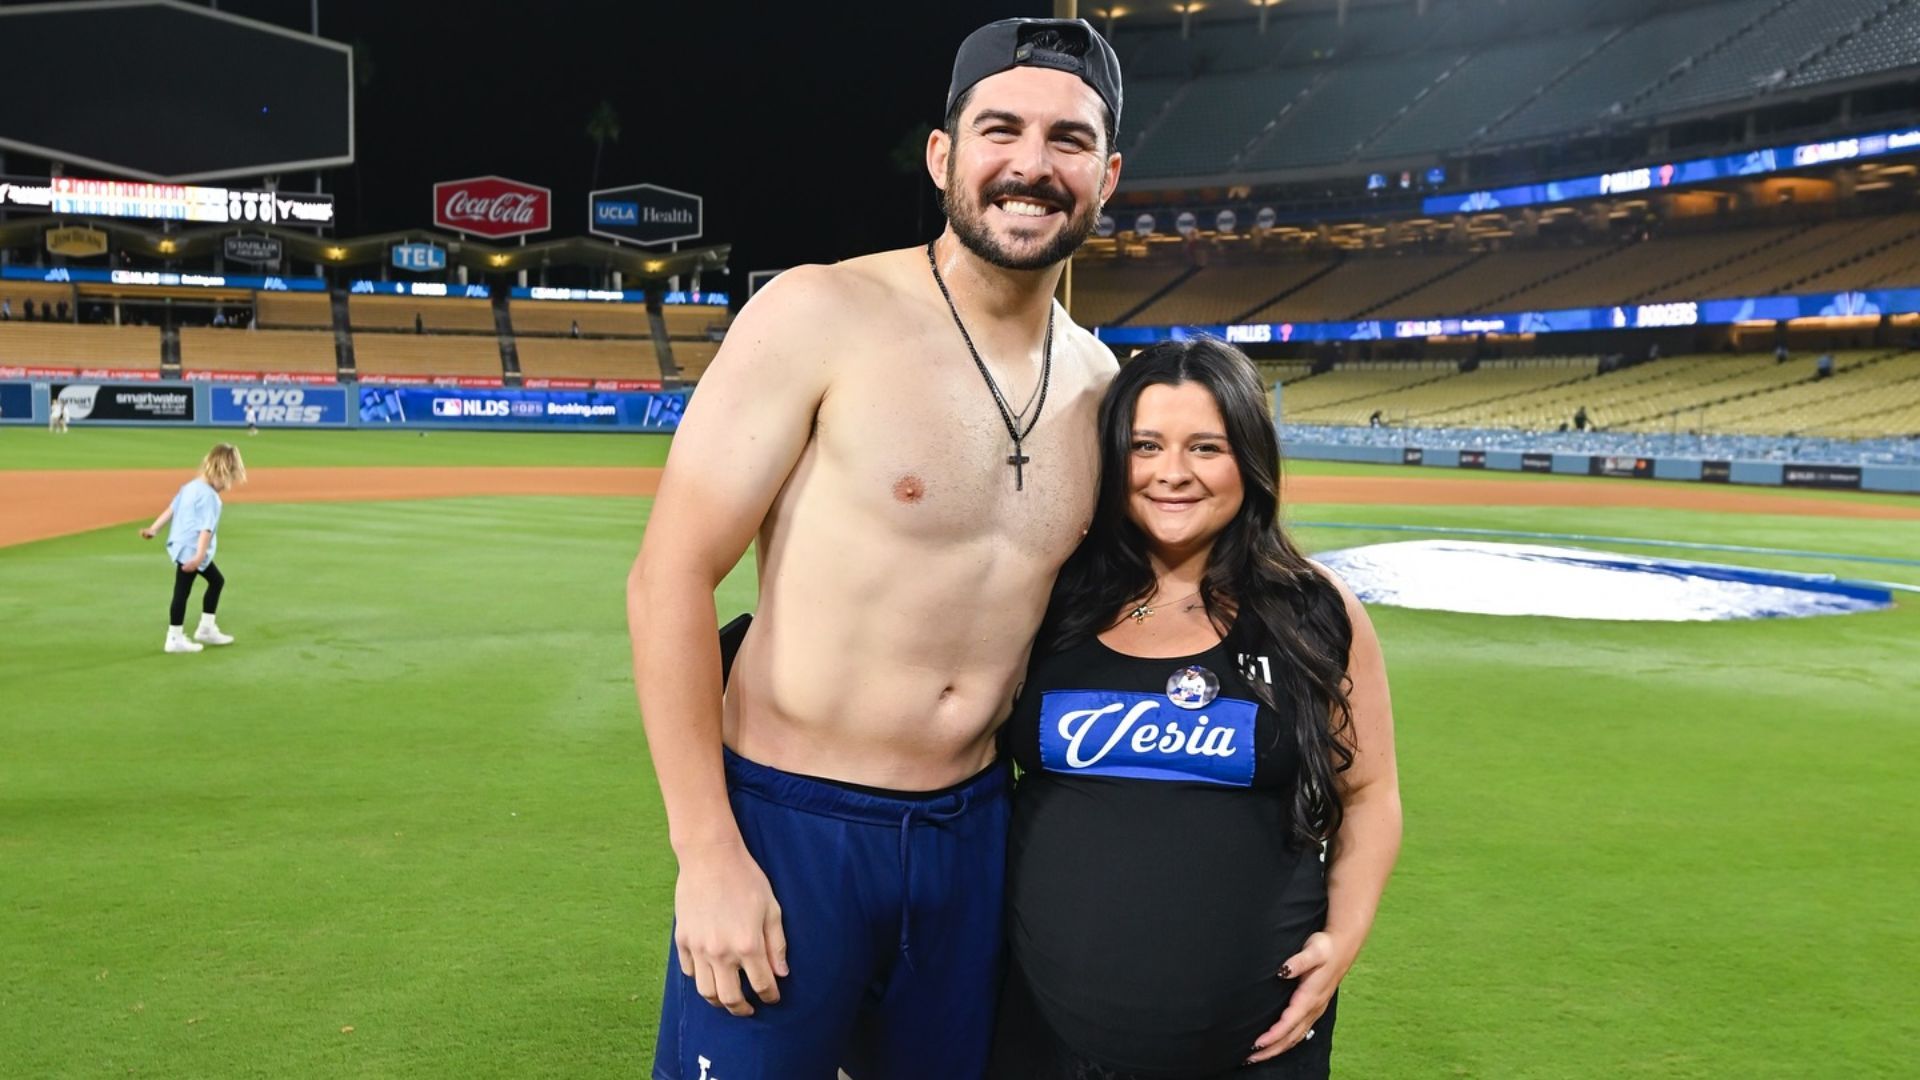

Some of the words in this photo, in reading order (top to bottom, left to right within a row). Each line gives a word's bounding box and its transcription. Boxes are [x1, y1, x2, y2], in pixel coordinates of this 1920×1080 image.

[445, 190, 540, 223] Coca-Cola
[599, 206, 635, 219] UCLA
[643, 207, 693, 224] Health
[398, 248, 440, 267] TEL
[116, 392, 187, 405] smartwater
[232, 388, 304, 406] TOYO
[244, 405, 322, 423] TIRES
[463, 399, 510, 416] NLDS
[547, 402, 616, 418] Booking.com
[1057, 700, 1237, 769] Vesia
